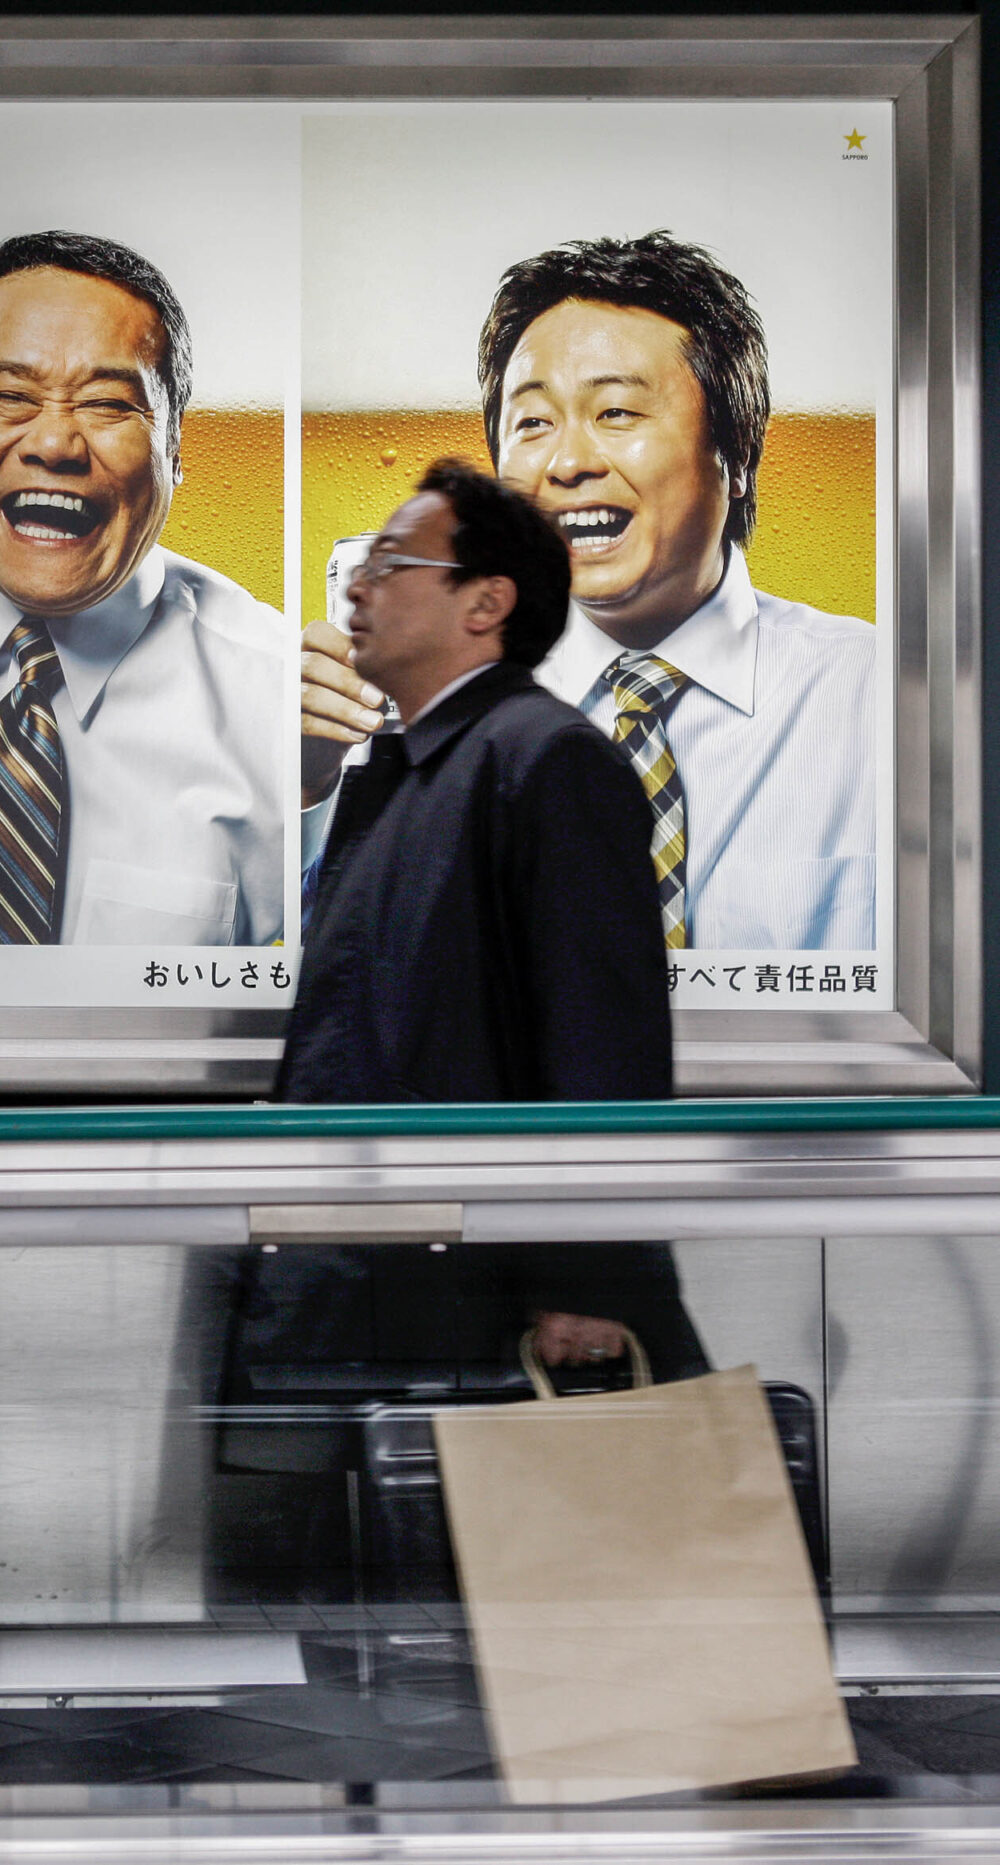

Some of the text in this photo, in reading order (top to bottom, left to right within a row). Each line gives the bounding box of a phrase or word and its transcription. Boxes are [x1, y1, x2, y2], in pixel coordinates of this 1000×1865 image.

[143, 961, 879, 993] おいしさも すべて責任品質
